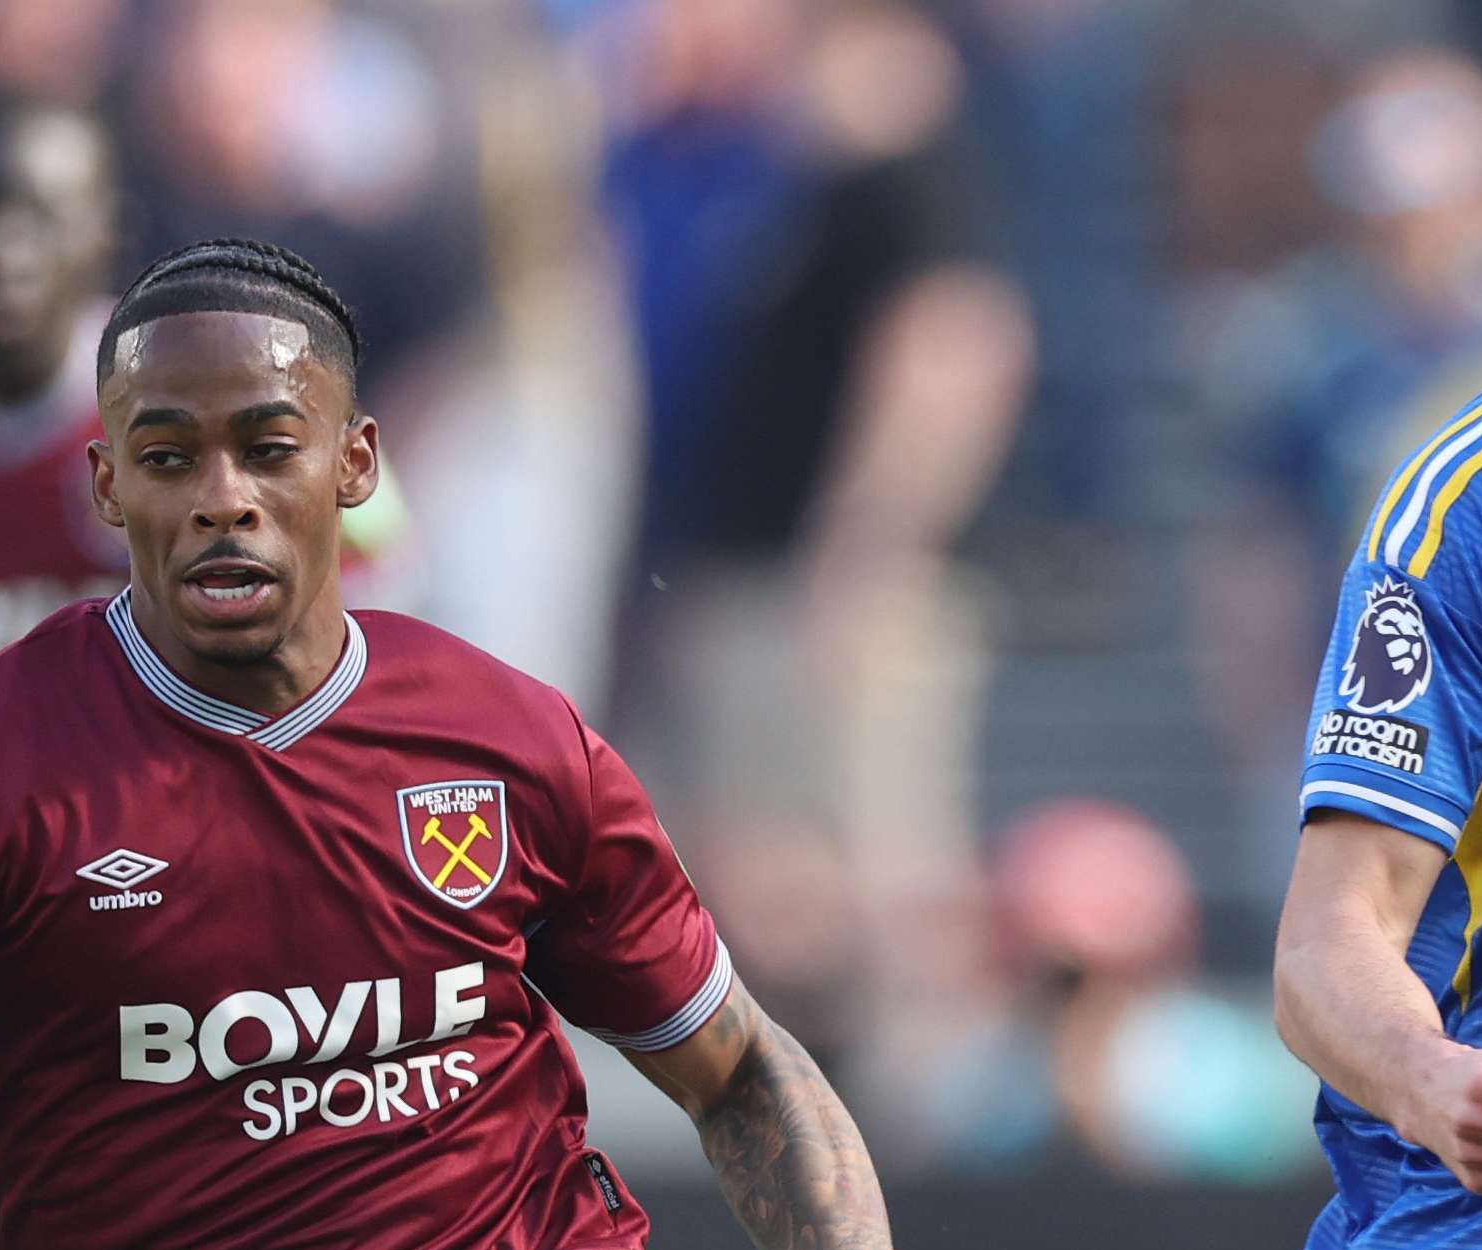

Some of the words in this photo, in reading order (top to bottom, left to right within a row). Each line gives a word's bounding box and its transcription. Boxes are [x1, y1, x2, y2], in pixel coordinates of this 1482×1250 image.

[1343, 715, 1418, 750] room
[1335, 735, 1424, 774] racism
[409, 788, 452, 808] WEST
[455, 787, 494, 803] HAM
[428, 801, 477, 815] UNITED
[89, 889, 163, 911] umbro
[446, 884, 483, 897] LONDON
[119, 961, 487, 1085] BOYLE
[242, 1050, 479, 1141] SPORTS
